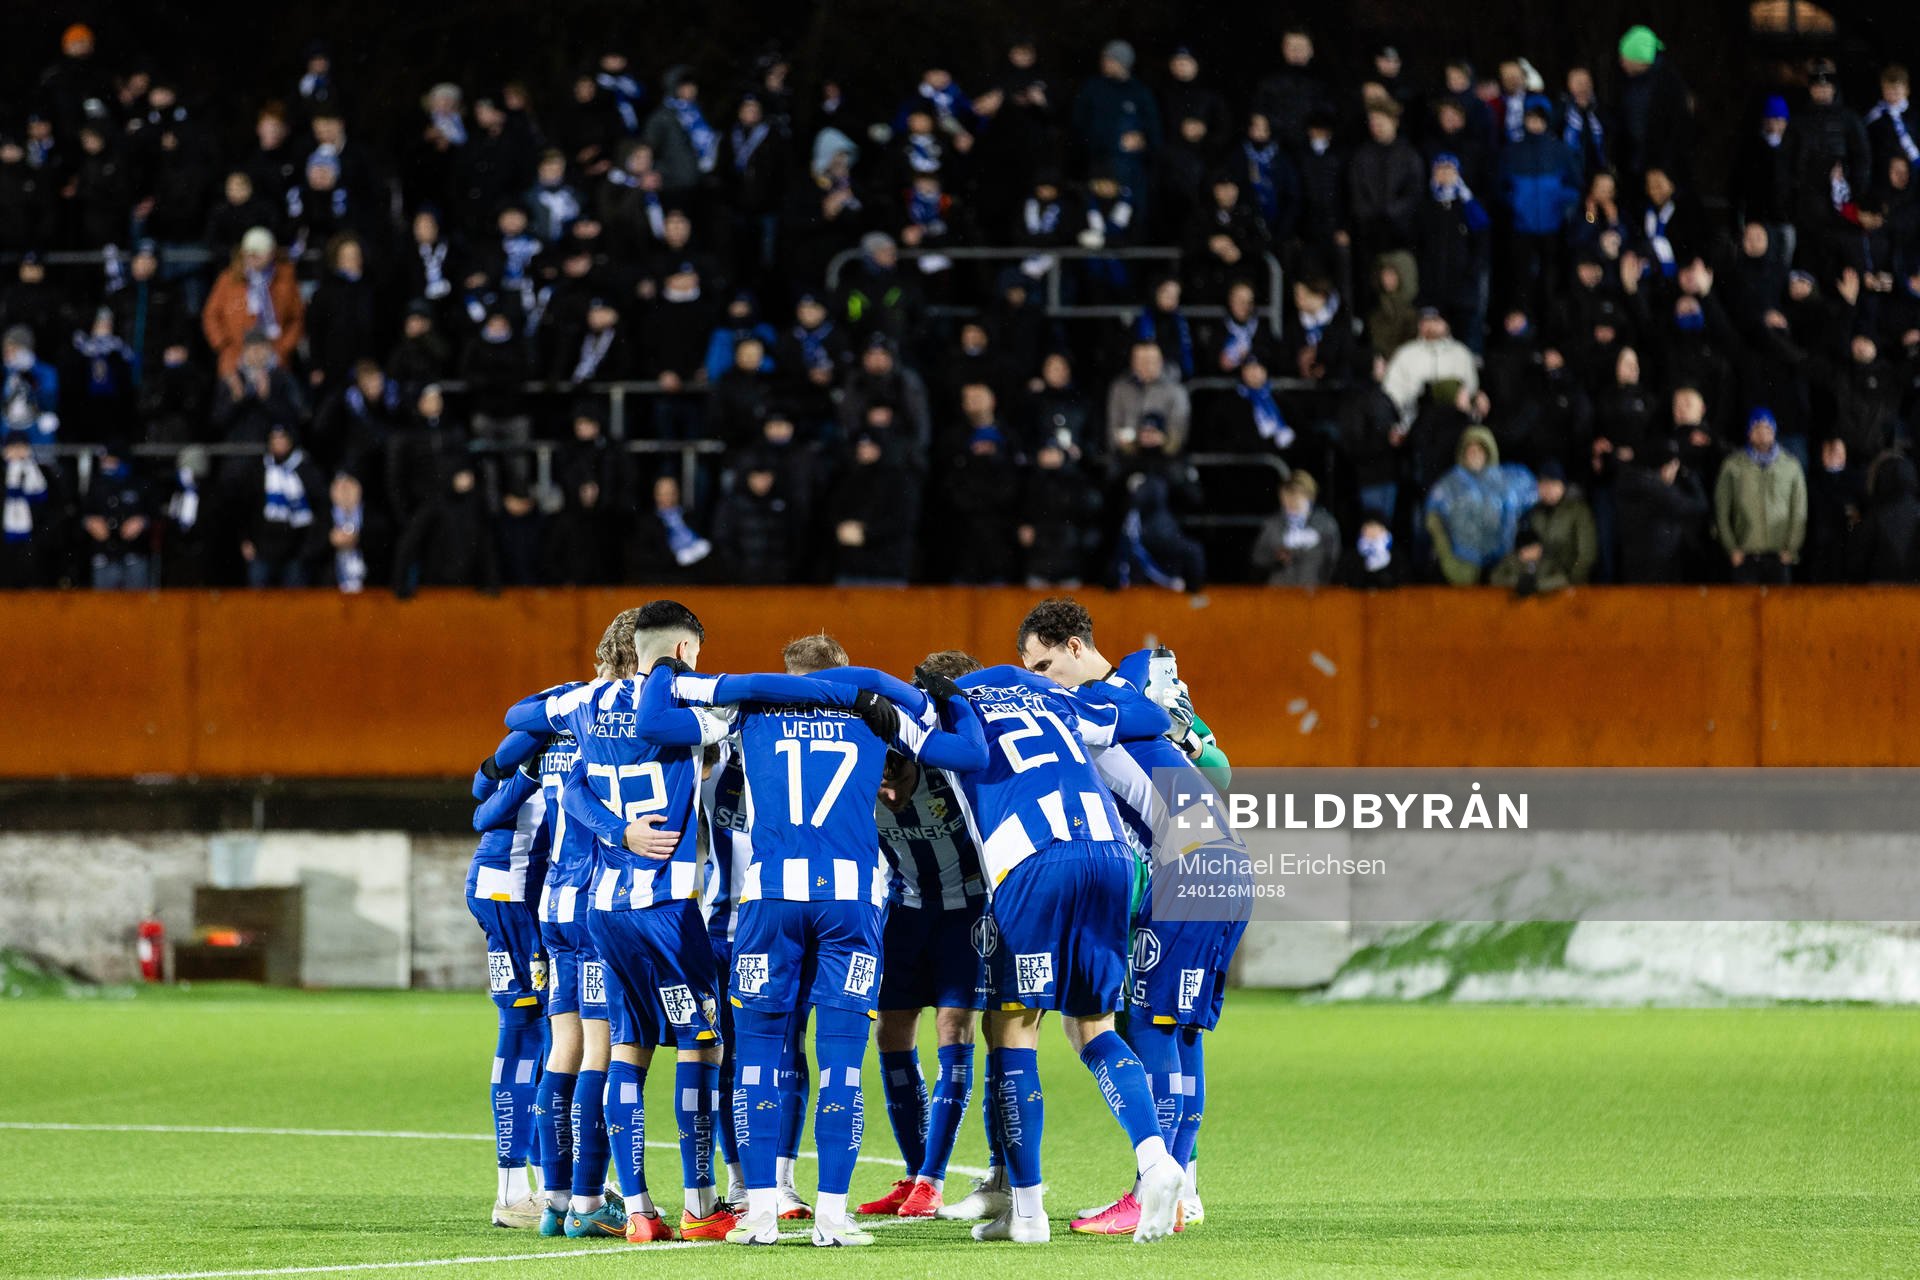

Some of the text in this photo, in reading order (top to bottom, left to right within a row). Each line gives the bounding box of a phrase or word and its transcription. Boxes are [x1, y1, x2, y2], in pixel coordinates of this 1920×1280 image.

[762, 706, 862, 719] WELLNESS
[782, 721, 846, 739] WENDT
[984, 709, 1086, 773] 21
[775, 739, 859, 829] 17
[715, 808, 749, 832] SE
[739, 957, 762, 969] EFF
[1018, 956, 1046, 969] EFF
[738, 969, 766, 980] EKT
[1020, 967, 1050, 980] EKT
[742, 979, 754, 991] IV
[848, 978, 864, 991] IV
[1020, 979, 1037, 991] IV
[585, 988, 600, 1000] IV
[663, 987, 688, 1001] EFF
[665, 998, 693, 1011] EKT
[668, 1010, 683, 1022] IV
[732, 1088, 750, 1148] SILFVERLOK
[848, 1090, 864, 1151] SILFVERLOK
[998, 1080, 1023, 1148] SILFVERLOK
[495, 1091, 514, 1159] SILFVERLOK
[571, 1103, 582, 1164] SILFVERLOK
[631, 1108, 645, 1176] SILFVERLOK
[693, 1114, 711, 1180] SILFVERLOK
